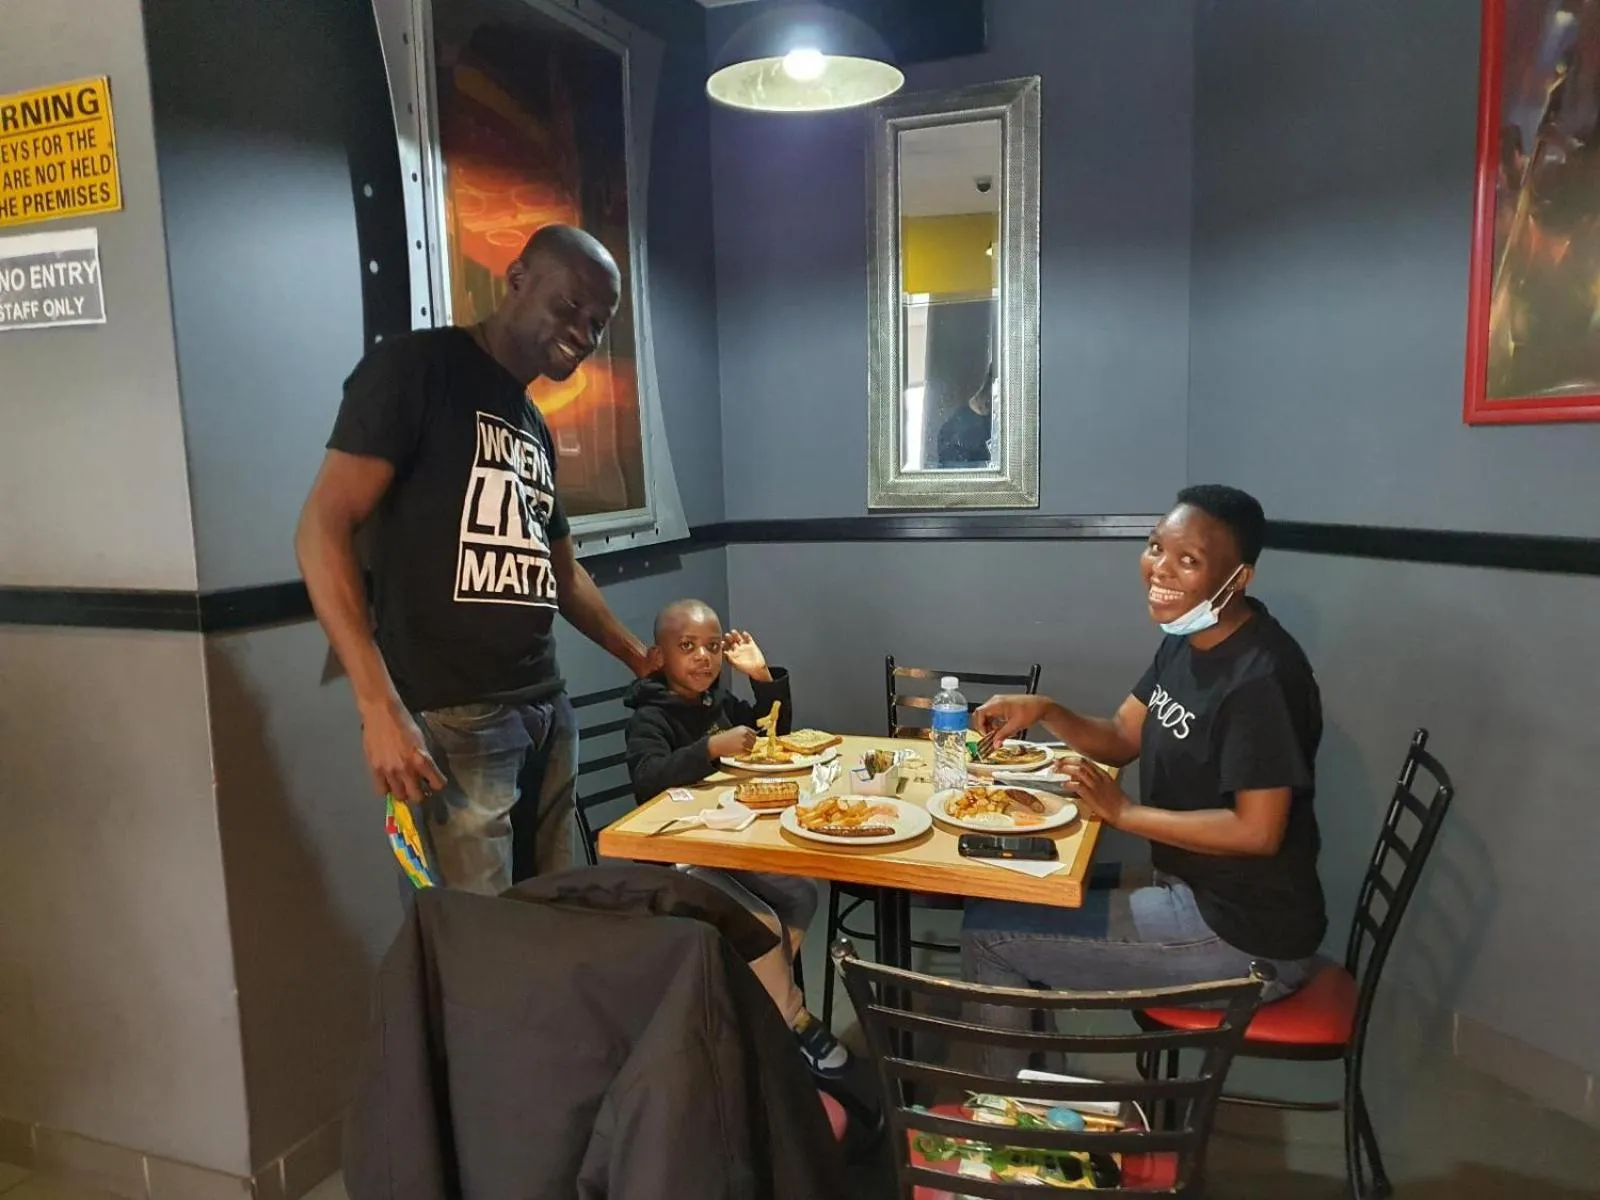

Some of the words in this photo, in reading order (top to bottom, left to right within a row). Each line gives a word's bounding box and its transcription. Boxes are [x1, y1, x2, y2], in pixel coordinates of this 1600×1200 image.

[1, 87, 100, 132] RNING
[33, 134, 63, 159] FOR
[66, 127, 97, 152] THE
[3, 167, 32, 192] ARE
[35, 160, 66, 186] NOT
[71, 153, 112, 180] HELD
[22, 182, 111, 214] PREMISES
[0, 267, 26, 293] NO
[29, 259, 97, 290] ENTRY
[0, 300, 39, 322] STAFF
[42, 295, 84, 318] ONLY
